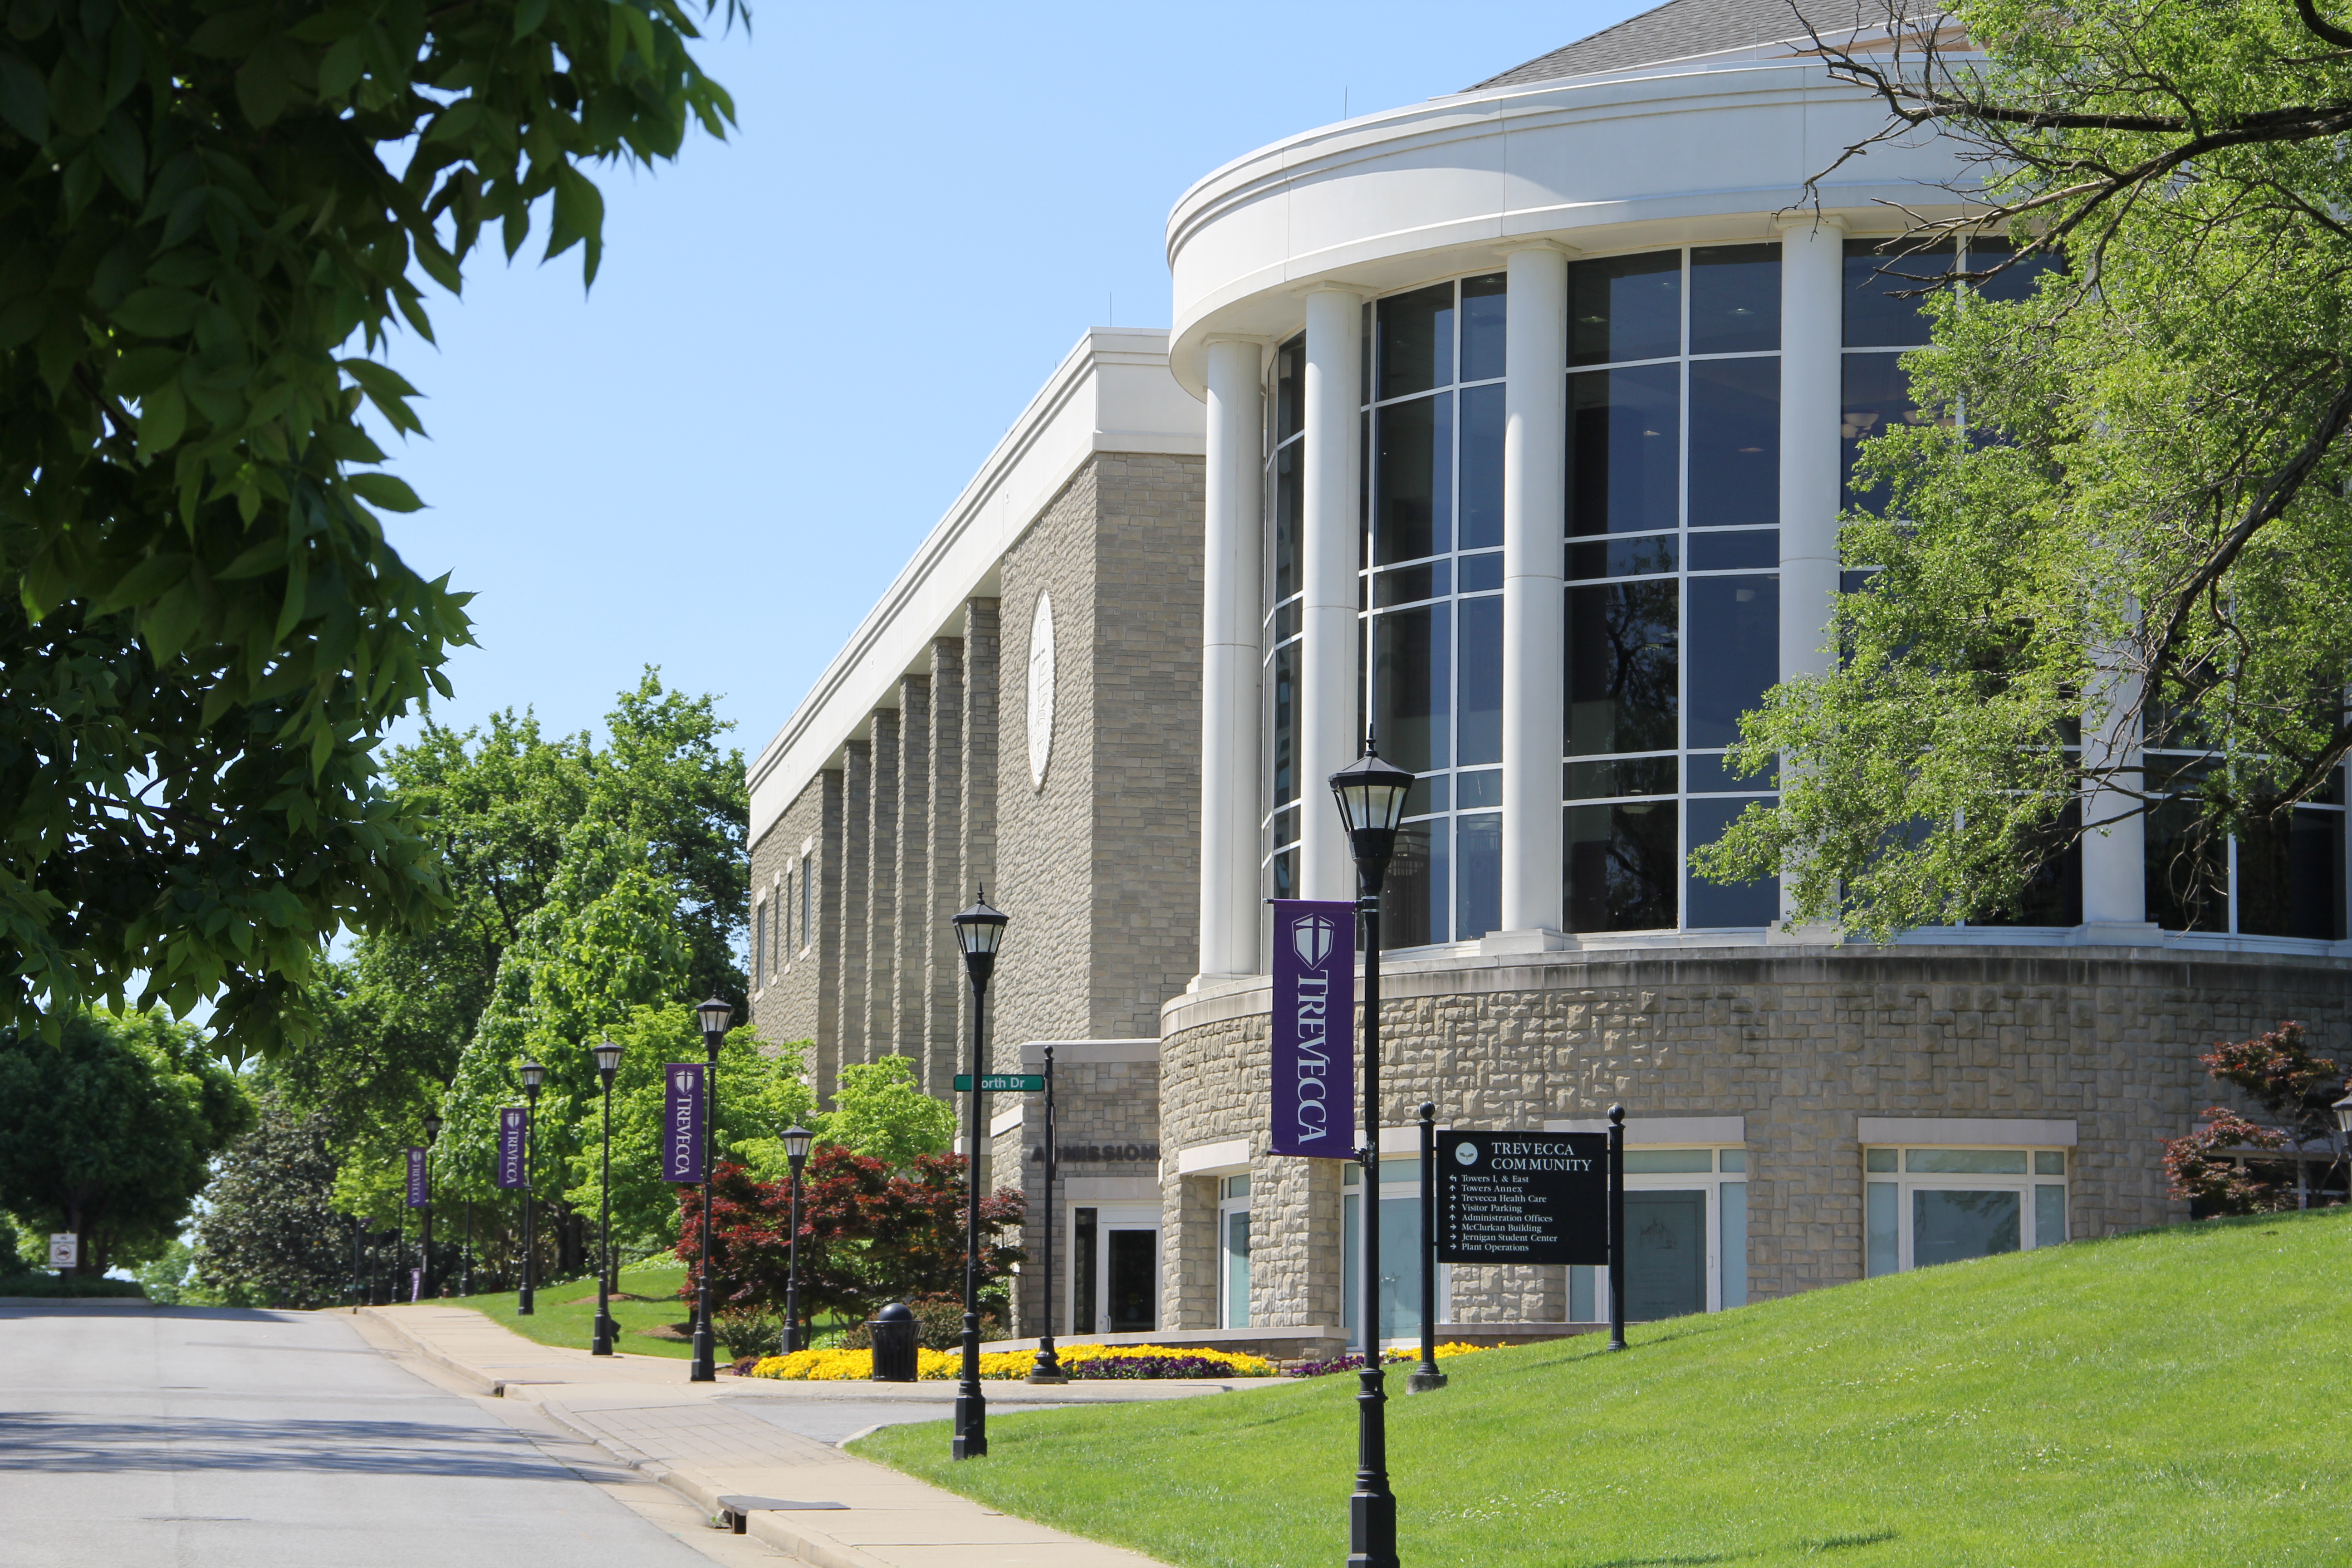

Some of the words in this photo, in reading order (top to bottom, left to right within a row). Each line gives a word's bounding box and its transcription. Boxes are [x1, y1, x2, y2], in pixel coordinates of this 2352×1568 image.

[1298, 969, 1330, 1145] TREVECCA
[982, 1077, 1006, 1089] orth
[1010, 1078, 1025, 1088] Dr
[675, 1094, 692, 1176] TREVECCA
[1491, 1142, 1574, 1155] TREVECCA
[506, 1128, 519, 1184] TREVECCA
[1491, 1158, 1592, 1171] COMMUNITY
[1491, 1204, 1522, 1214] Parking
[1462, 1223, 1505, 1231] McClurkan
[1508, 1224, 1542, 1233] Building
[1461, 1233, 1496, 1242] Jernigan
[1485, 1244, 1529, 1253] Operations
